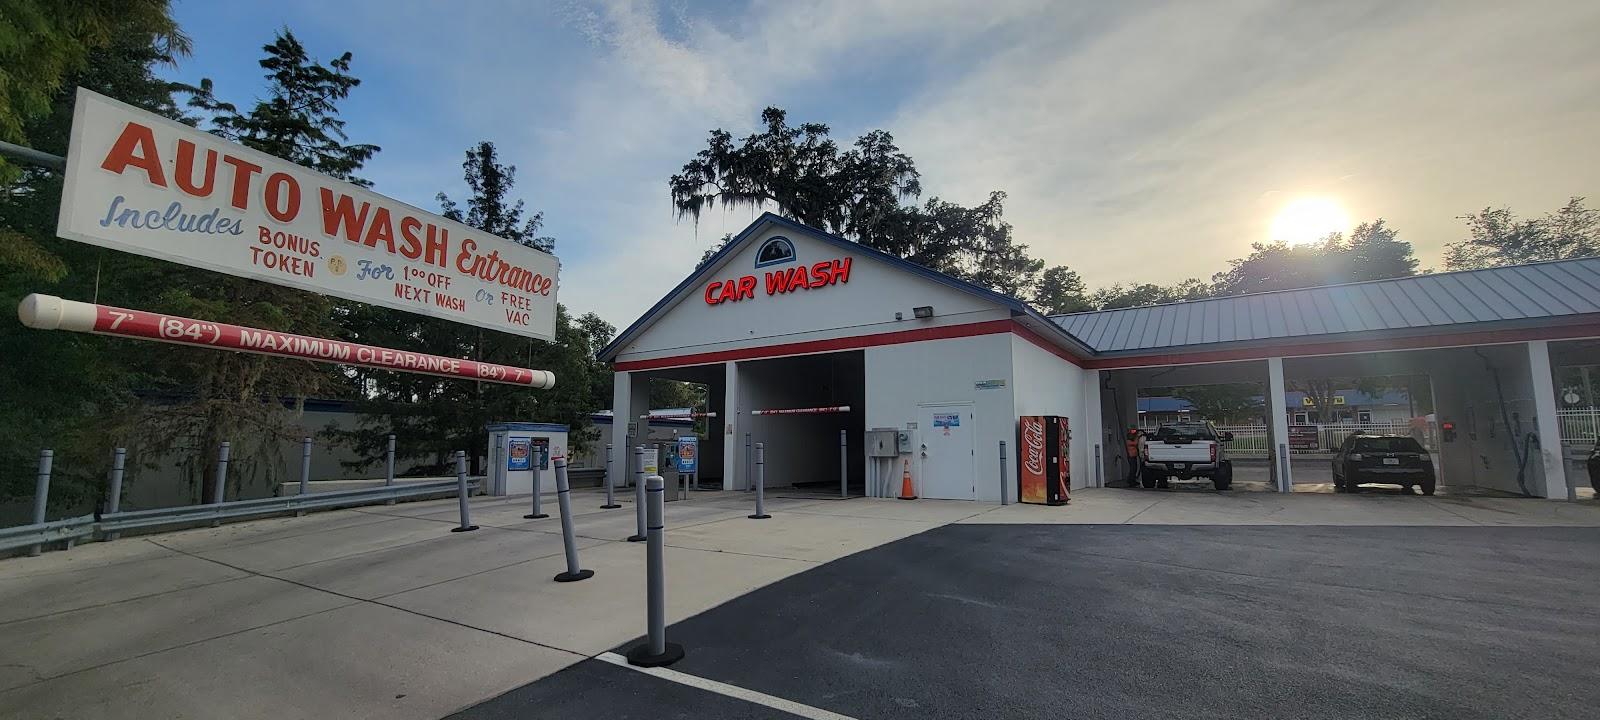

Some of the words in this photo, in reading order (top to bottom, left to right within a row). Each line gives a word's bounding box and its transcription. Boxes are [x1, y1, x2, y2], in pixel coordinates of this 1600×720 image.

[100, 195, 244, 236] Includes
[101, 121, 301, 222] AUTO
[319, 186, 448, 268] WASH
[455, 238, 552, 297] Entrance
[258, 225, 321, 258] BONUS
[250, 246, 314, 278] TOKEN
[357, 259, 394, 281] For
[427, 273, 451, 291] OFF
[704, 275, 757, 306] CAR
[765, 256, 853, 297] WASH
[394, 283, 431, 304] NEXT
[435, 292, 465, 312] WASH
[501, 291, 532, 311] FREE
[505, 308, 530, 326] VAC
[109, 311, 134, 330] 7'
[158, 316, 221, 344] (84")
[240, 329, 350, 361] MAXIMUM
[357, 347, 461, 374] CLEARANCE
